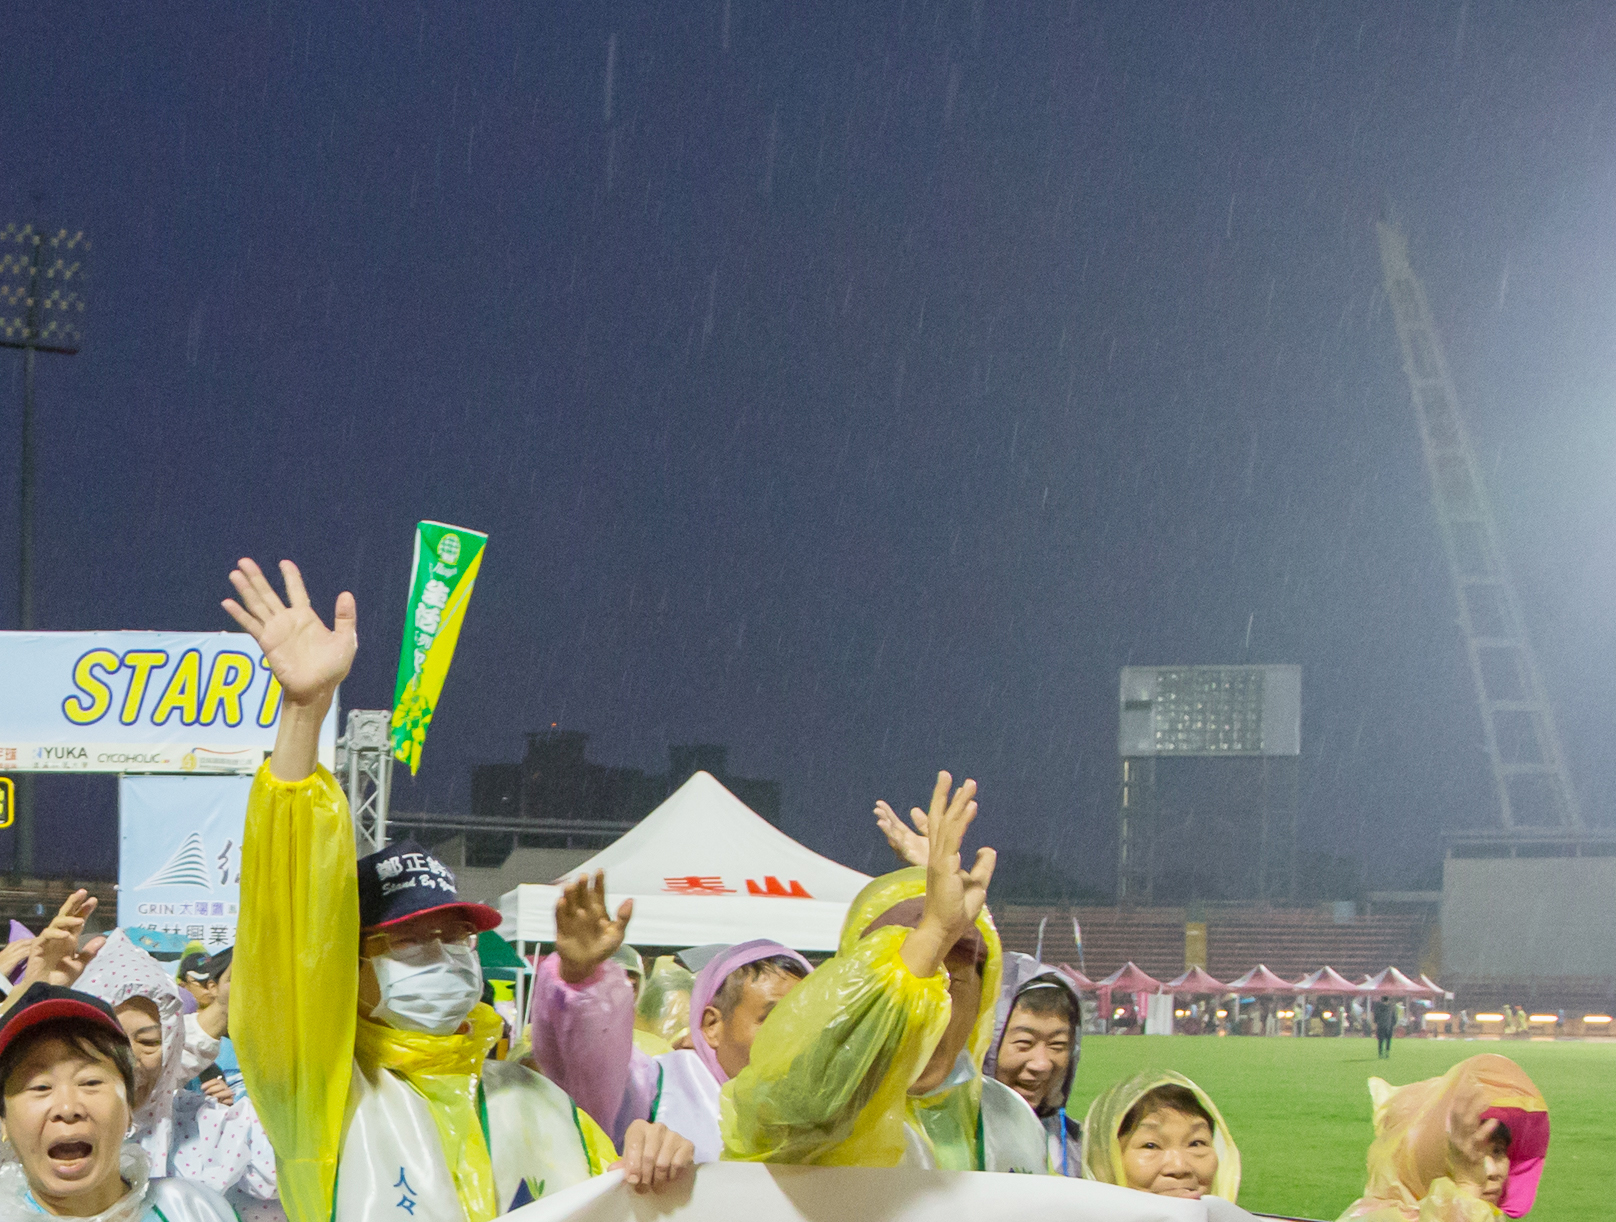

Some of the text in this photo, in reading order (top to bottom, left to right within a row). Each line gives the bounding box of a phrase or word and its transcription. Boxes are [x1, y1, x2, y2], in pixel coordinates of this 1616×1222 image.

[61, 648, 283, 728] START
[43, 746, 89, 759] YUKA
[138, 904, 175, 915] GRIN
